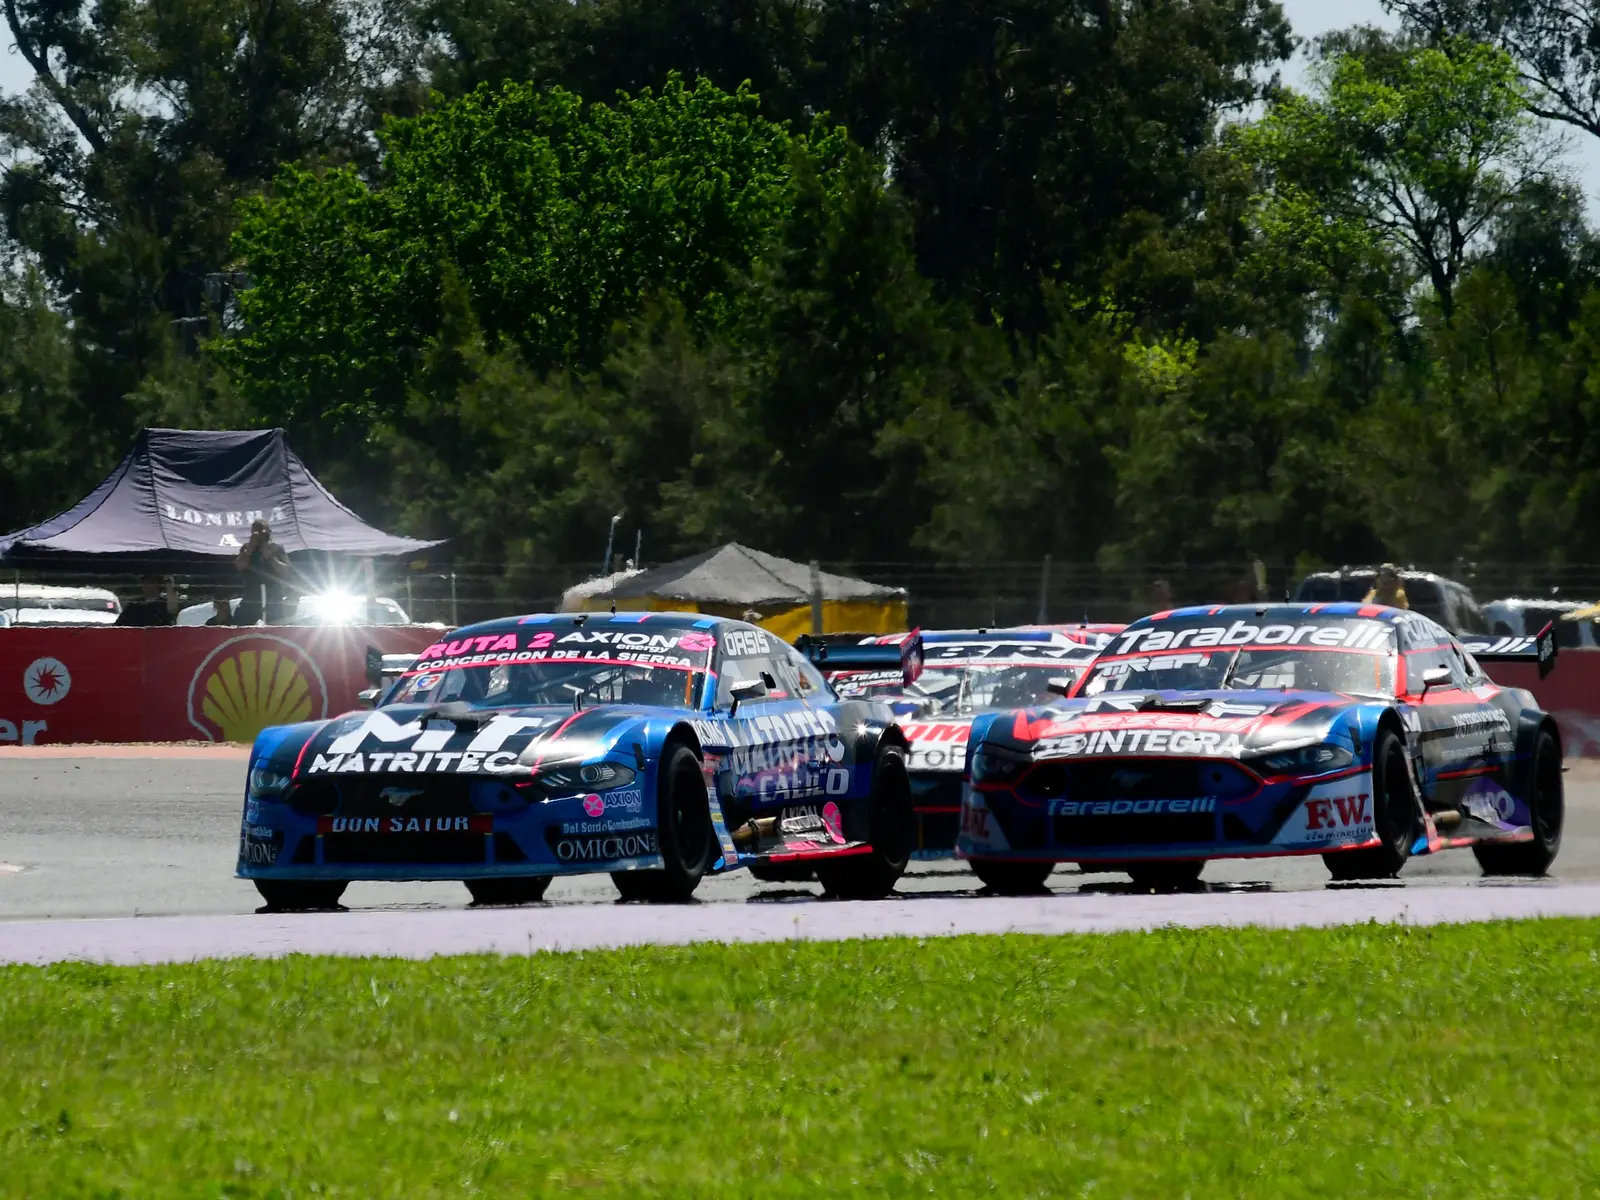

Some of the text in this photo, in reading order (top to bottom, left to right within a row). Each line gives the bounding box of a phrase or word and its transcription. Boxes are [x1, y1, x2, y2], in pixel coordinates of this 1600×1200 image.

[419, 632, 556, 660] RUTA 2
[557, 631, 682, 649] AXION
[616, 643, 669, 653] energy
[724, 631, 771, 656] OASIS
[1116, 620, 1397, 654] Taraborelli
[416, 650, 692, 672] CONCEPCION DE LA SIERRA
[1084, 729, 1242, 759] INTEGRA
[308, 751, 520, 774] MATRITEC
[604, 789, 641, 808] AXION
[1048, 795, 1217, 816] Taraborelli
[332, 816, 380, 833] DON
[563, 822, 579, 834] Del
[581, 820, 607, 833] Sordo
[557, 834, 651, 860] OMICRON
